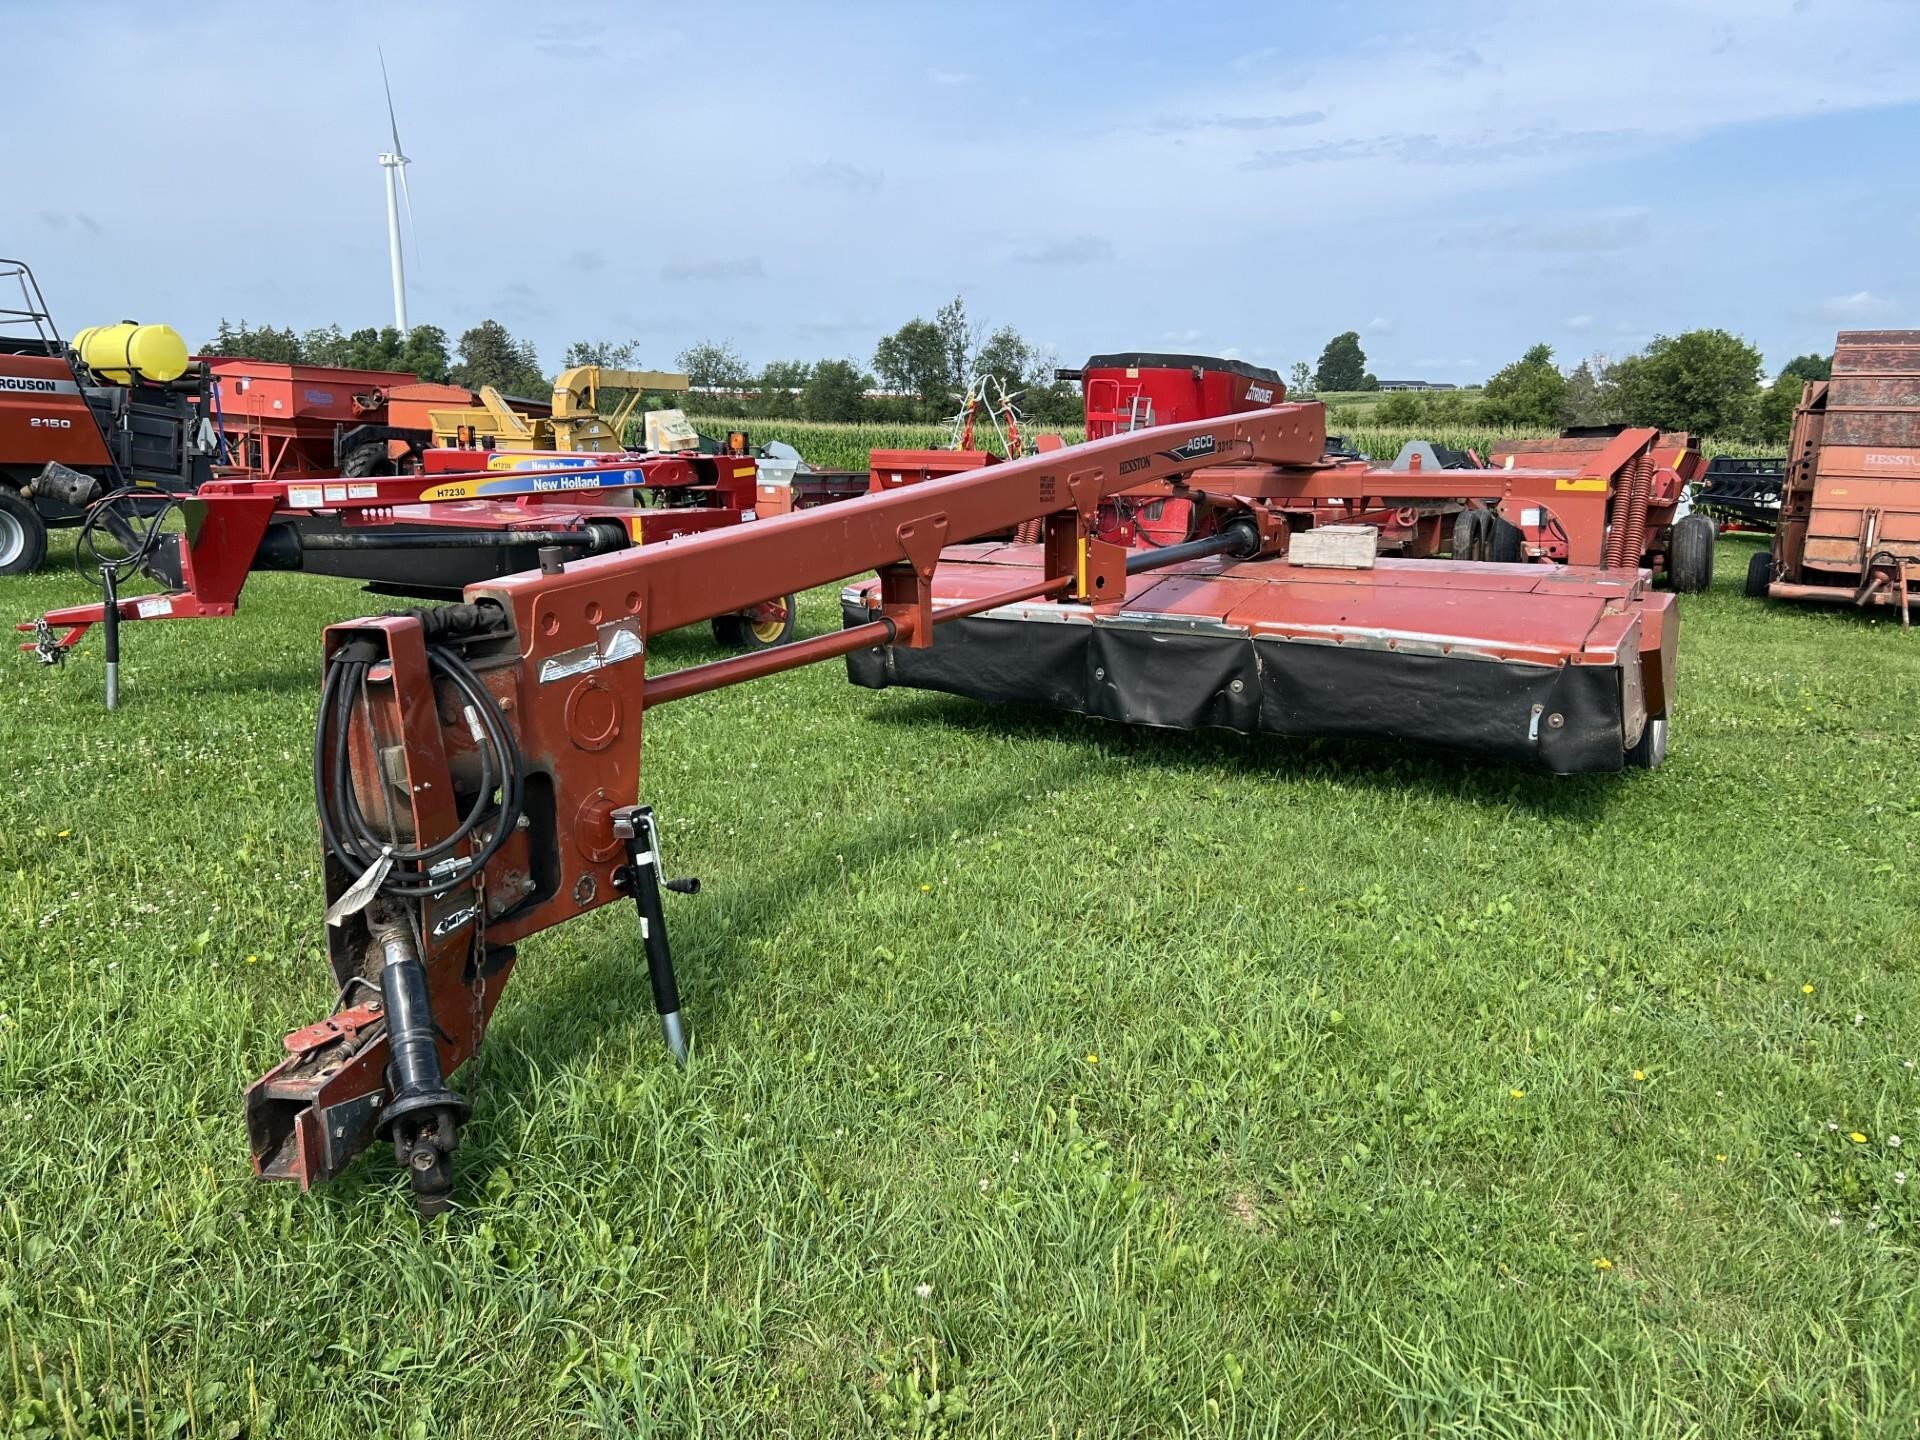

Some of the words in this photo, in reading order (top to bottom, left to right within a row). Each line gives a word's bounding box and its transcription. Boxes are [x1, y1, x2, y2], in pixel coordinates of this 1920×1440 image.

[30, 418, 71, 428] 2150
[1187, 434, 1213, 451] AGCO
[437, 488, 466, 498] H7230
[533, 478, 559, 491] New
[560, 475, 600, 489] Holland
